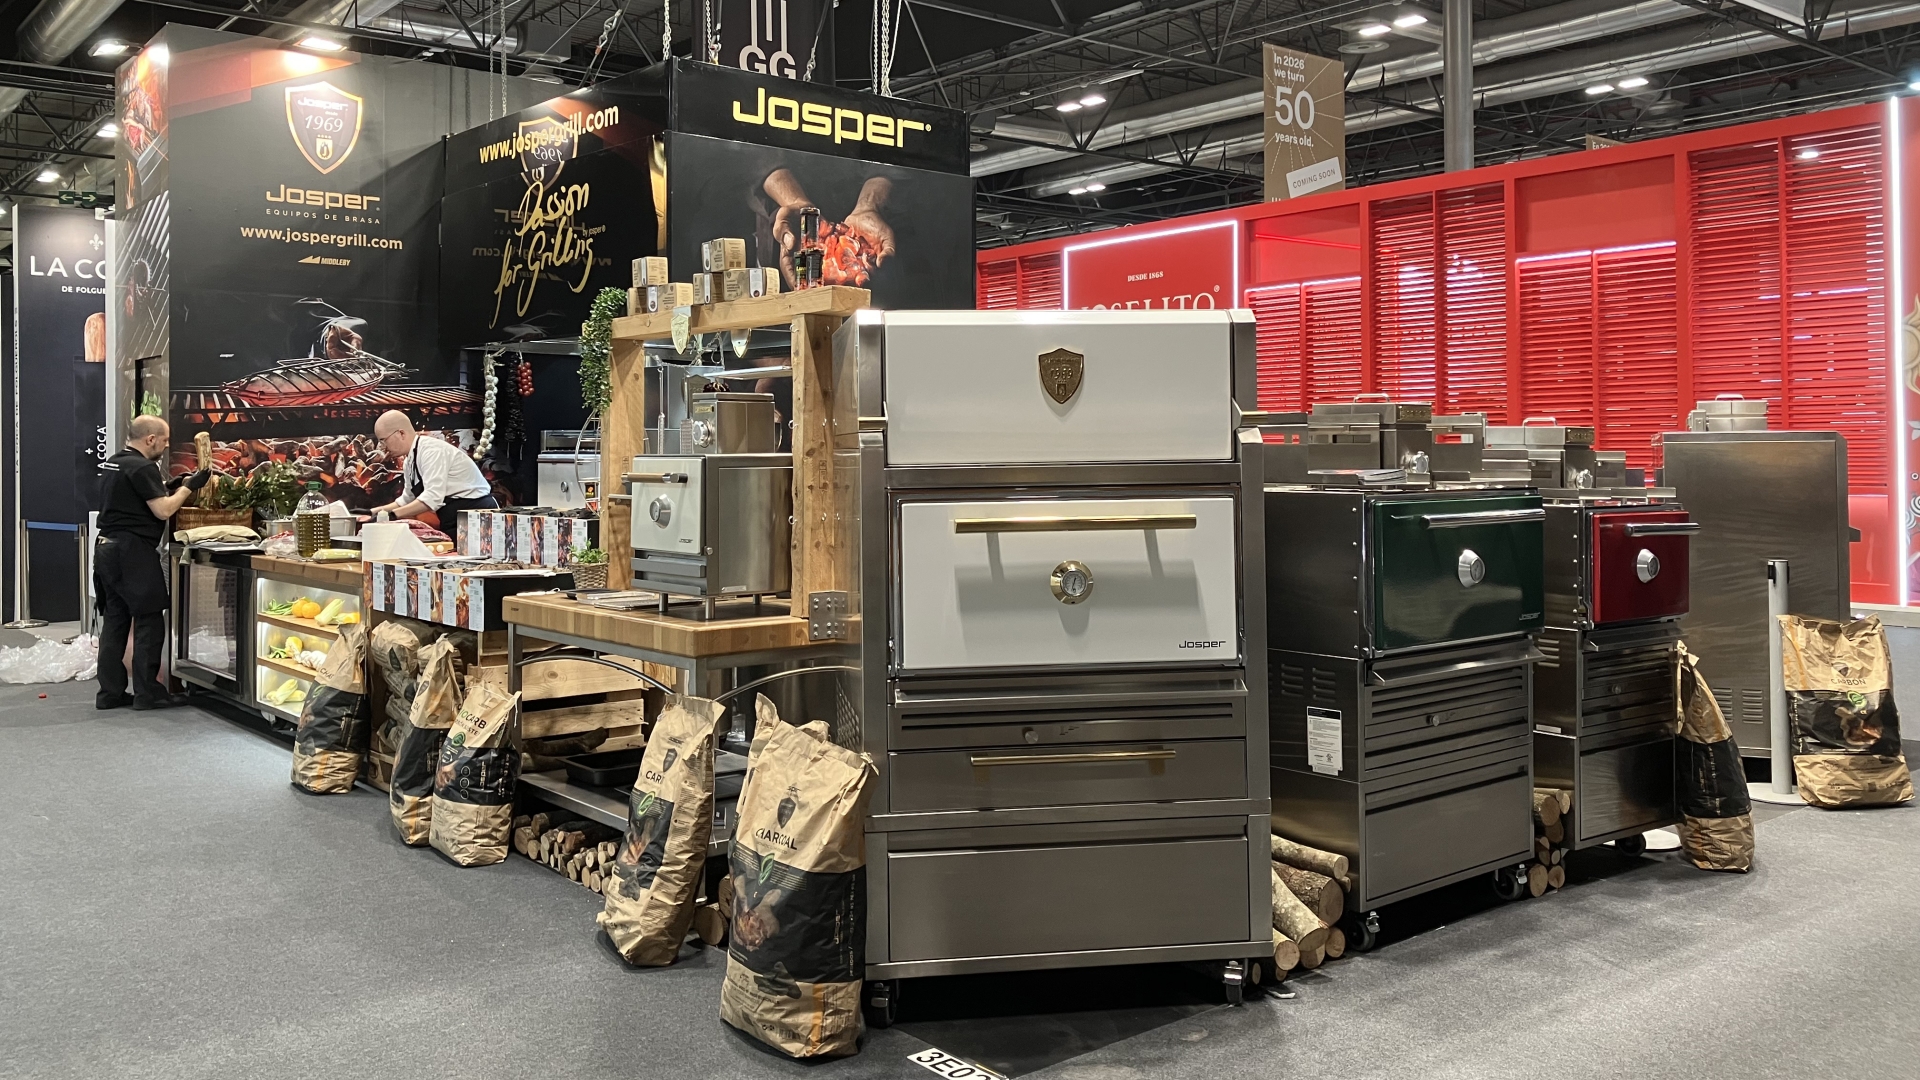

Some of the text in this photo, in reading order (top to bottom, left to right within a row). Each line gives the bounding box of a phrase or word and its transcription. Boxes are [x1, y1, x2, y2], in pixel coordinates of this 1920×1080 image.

[1273, 53, 1305, 70] In 2026
[1274, 69, 1305, 83] we turn
[1274, 85, 1315, 130] 50
[305, 114, 343, 133] 1969
[479, 104, 619, 164] www.jospergrill.com
[1274, 133, 1314, 148] years old.
[1292, 161, 1336, 189] COMING SOON
[266, 208, 381, 225] EQUIPOS DE BRASA
[514, 181, 590, 256] Passion
[240, 226, 403, 250] www.jospergrill.com
[30, 255, 69, 278] LA
[320, 257, 352, 266] MIDDLEBY
[488, 217, 594, 330] for Grilling
[1127, 271, 1164, 282] DESDE 1868
[61, 285, 73, 293] DE
[1178, 640, 1227, 649] Josper
[755, 827, 798, 851] CHARCOAL
